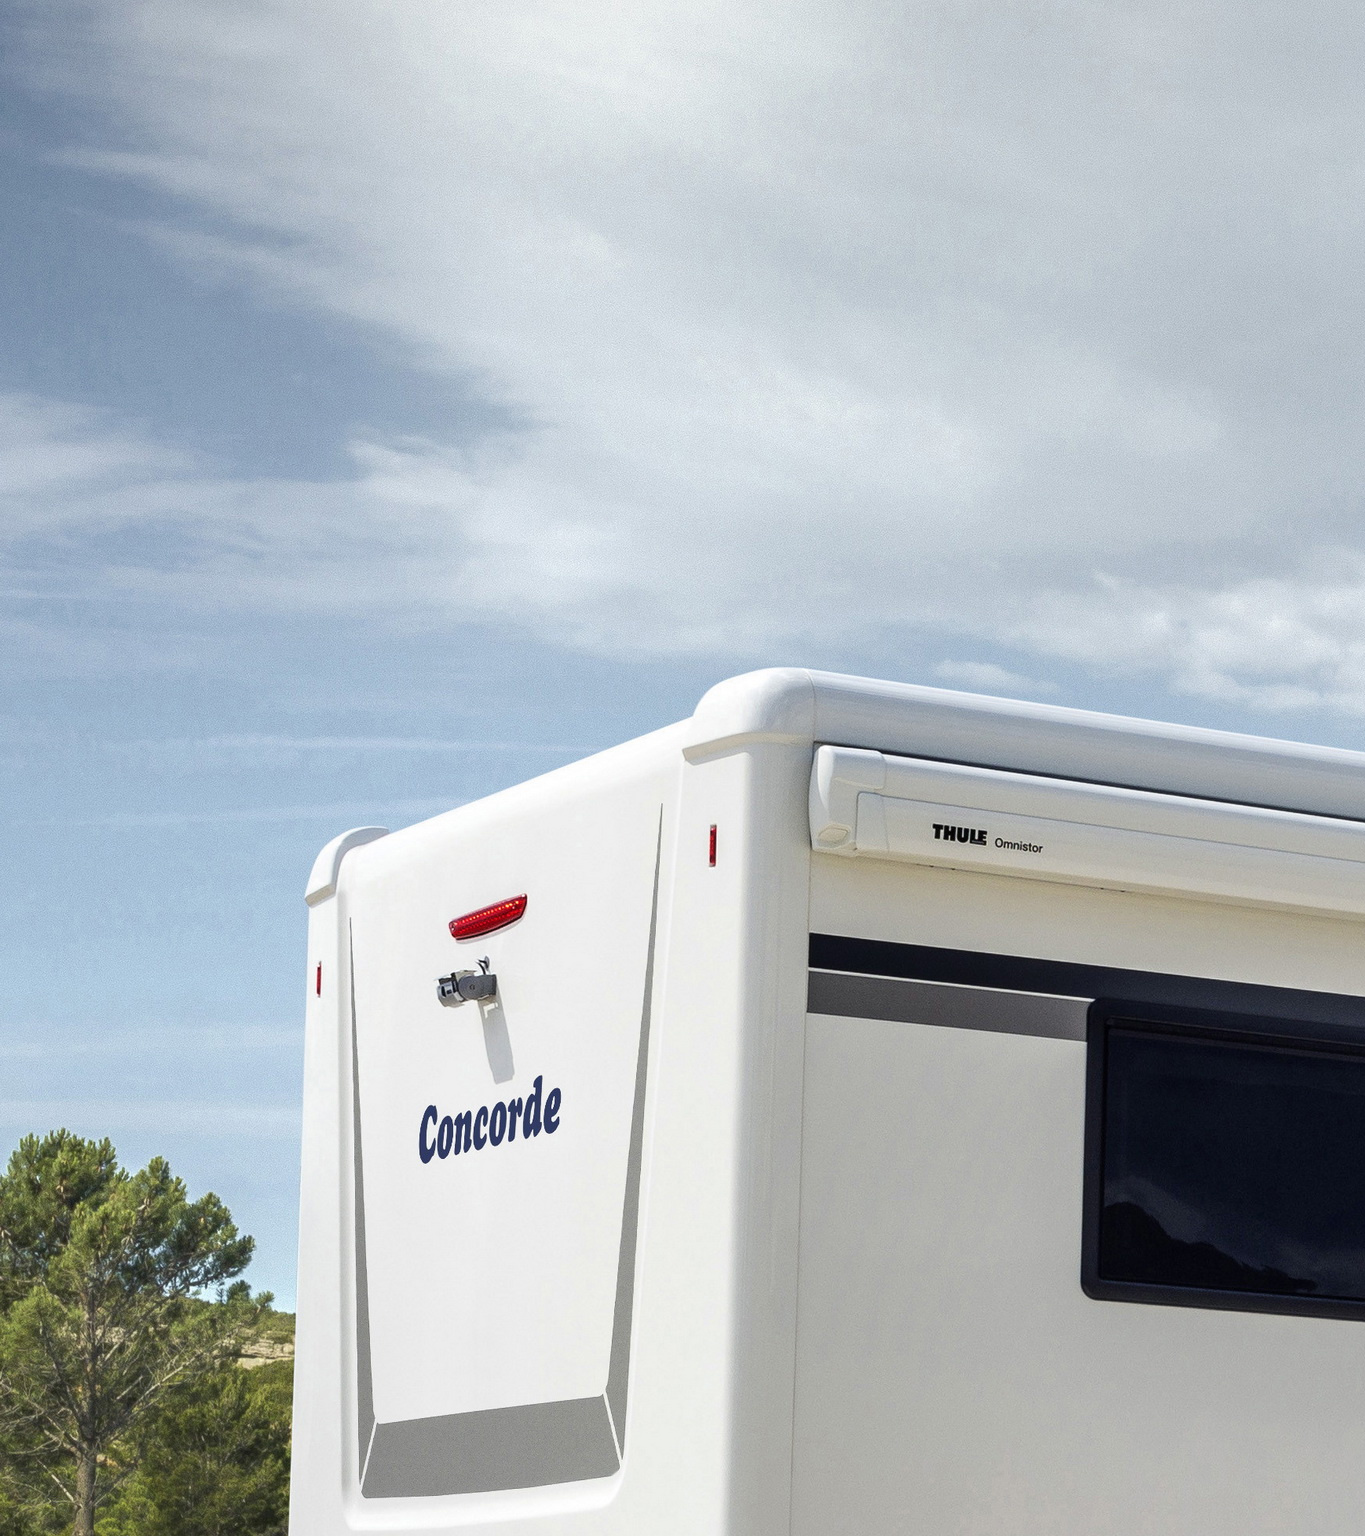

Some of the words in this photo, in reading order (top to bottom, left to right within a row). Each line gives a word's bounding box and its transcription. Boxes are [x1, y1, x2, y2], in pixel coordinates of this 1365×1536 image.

[932, 823, 988, 846] THULE
[994, 837, 1044, 854] Omnistor
[418, 1074, 562, 1165] Concorde
